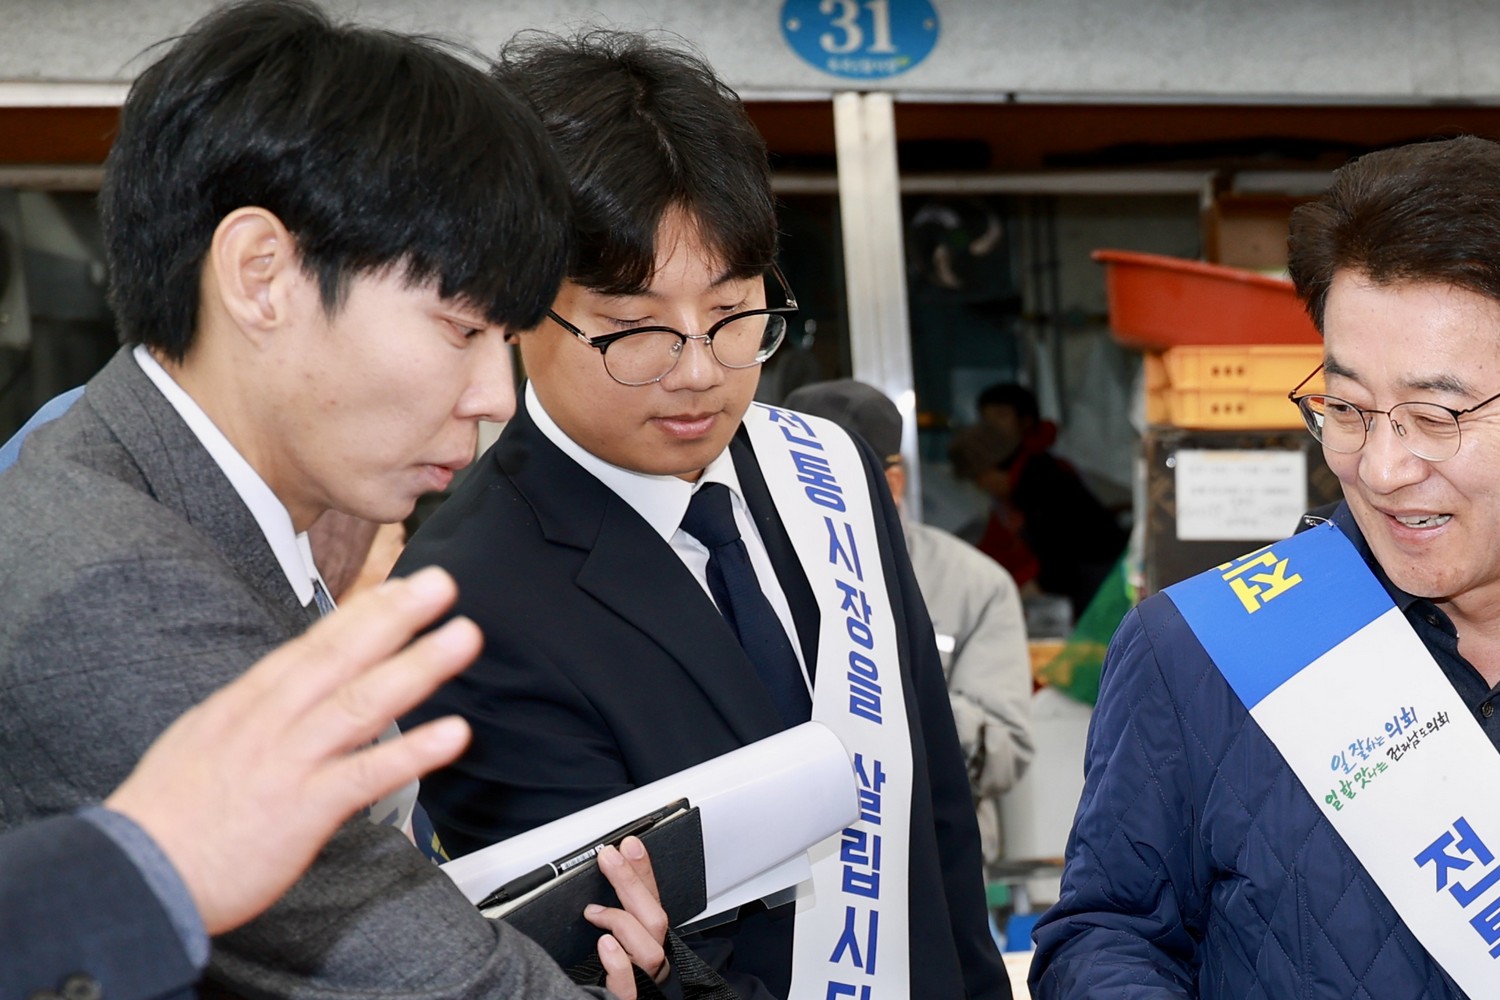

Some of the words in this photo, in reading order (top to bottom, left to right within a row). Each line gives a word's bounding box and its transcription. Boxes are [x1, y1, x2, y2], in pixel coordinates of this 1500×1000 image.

[819, 0, 898, 54] 31
[752, 403, 884, 725] 전통시장을
[1208, 544, 1303, 615] 전
[1331, 750, 1357, 774] 일
[1348, 736, 1385, 760] 잘하는
[1384, 706, 1418, 738] 의회
[1354, 761, 1388, 789] 맛나는
[1386, 711, 1450, 761] 전라남도의회
